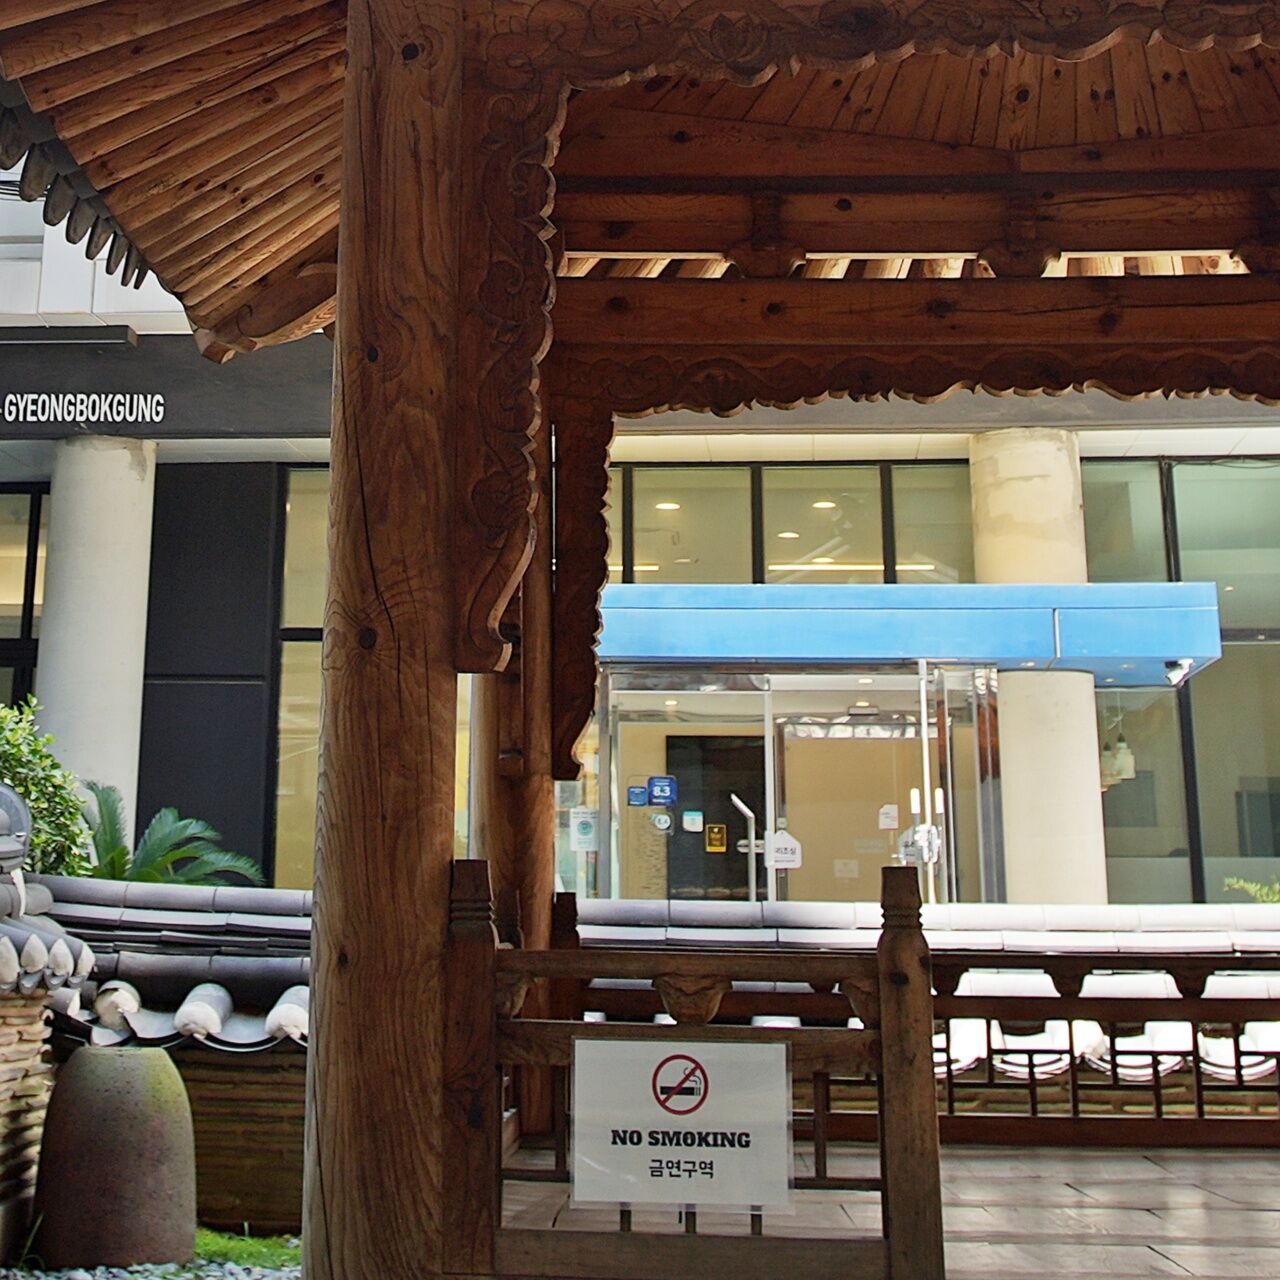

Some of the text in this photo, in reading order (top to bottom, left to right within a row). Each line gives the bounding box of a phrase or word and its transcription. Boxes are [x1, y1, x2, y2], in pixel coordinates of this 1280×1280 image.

[652, 786, 671, 797] 8.3
[611, 1129, 751, 1148] NO SMOKING
[649, 1159, 714, 1179] 금연구역
